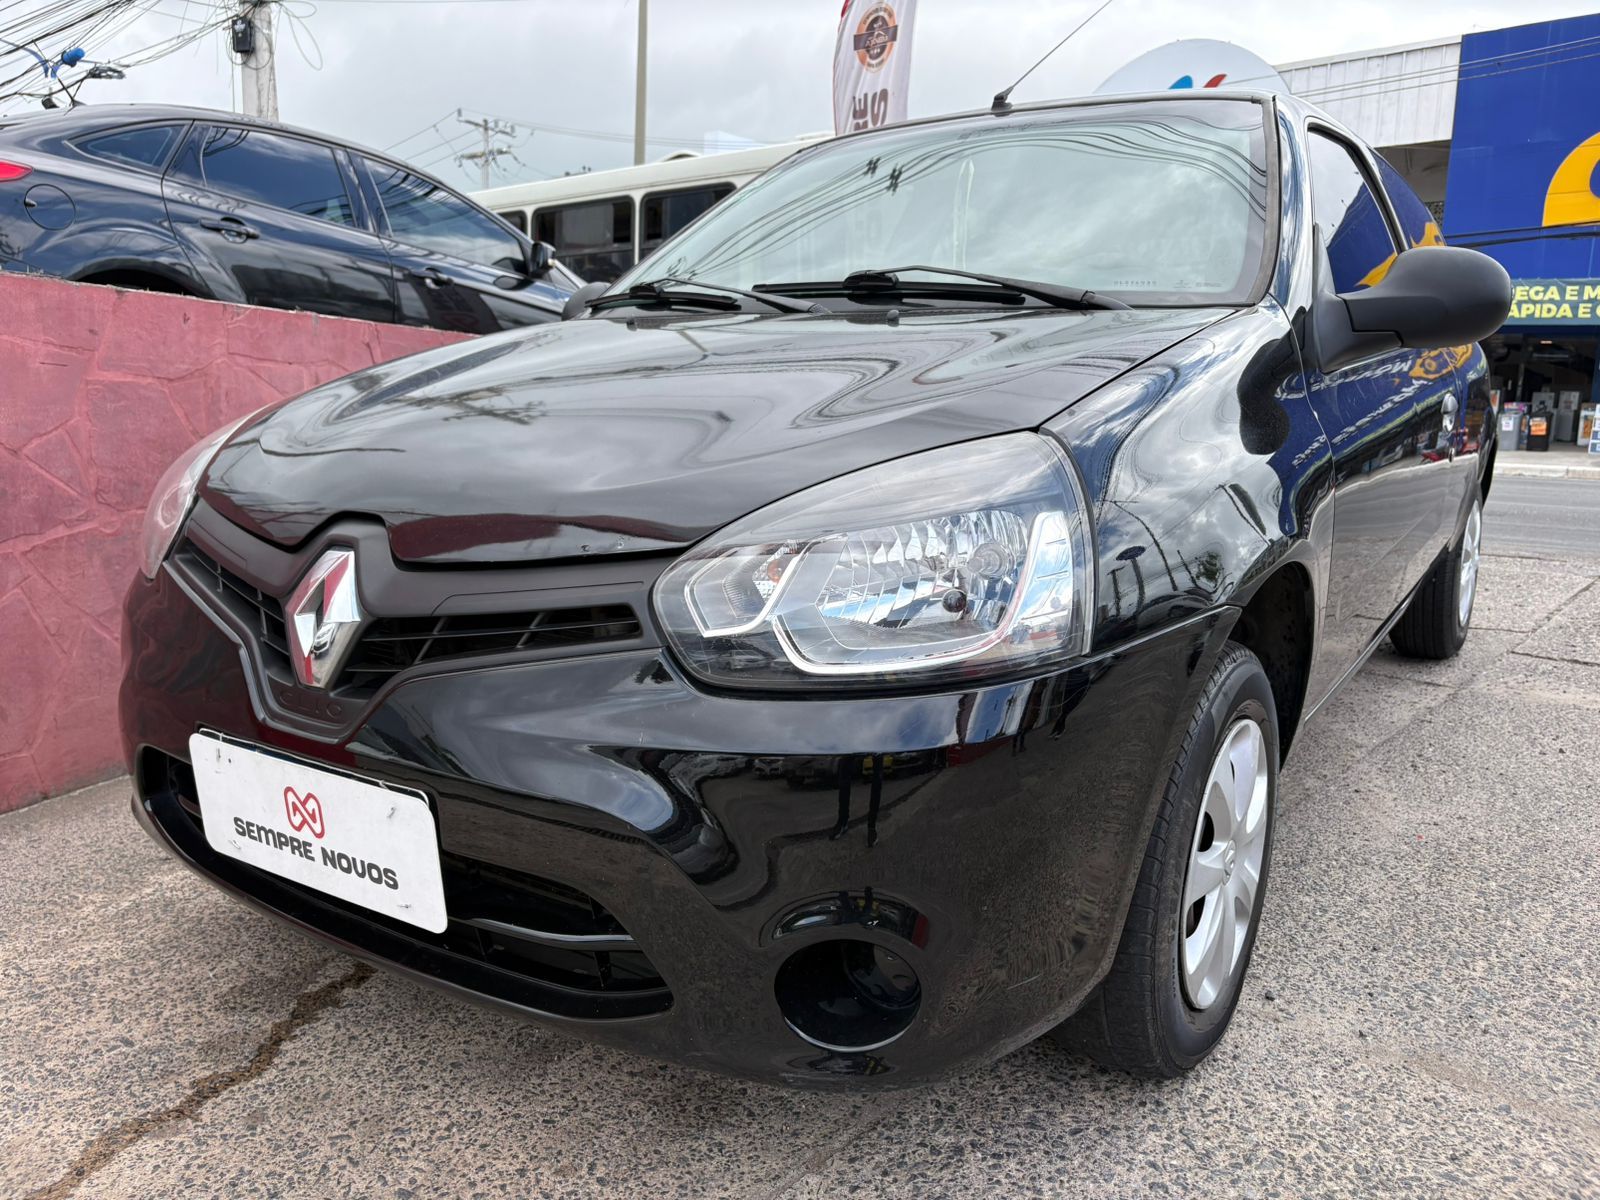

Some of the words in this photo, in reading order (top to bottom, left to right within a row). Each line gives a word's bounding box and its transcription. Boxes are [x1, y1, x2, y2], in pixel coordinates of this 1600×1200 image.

[1512, 285, 1560, 301] EGA
[1565, 285, 1579, 300] E
[1578, 303, 1592, 318] E
[233, 816, 315, 862] SEMPRE
[321, 846, 399, 890] NOVOS
